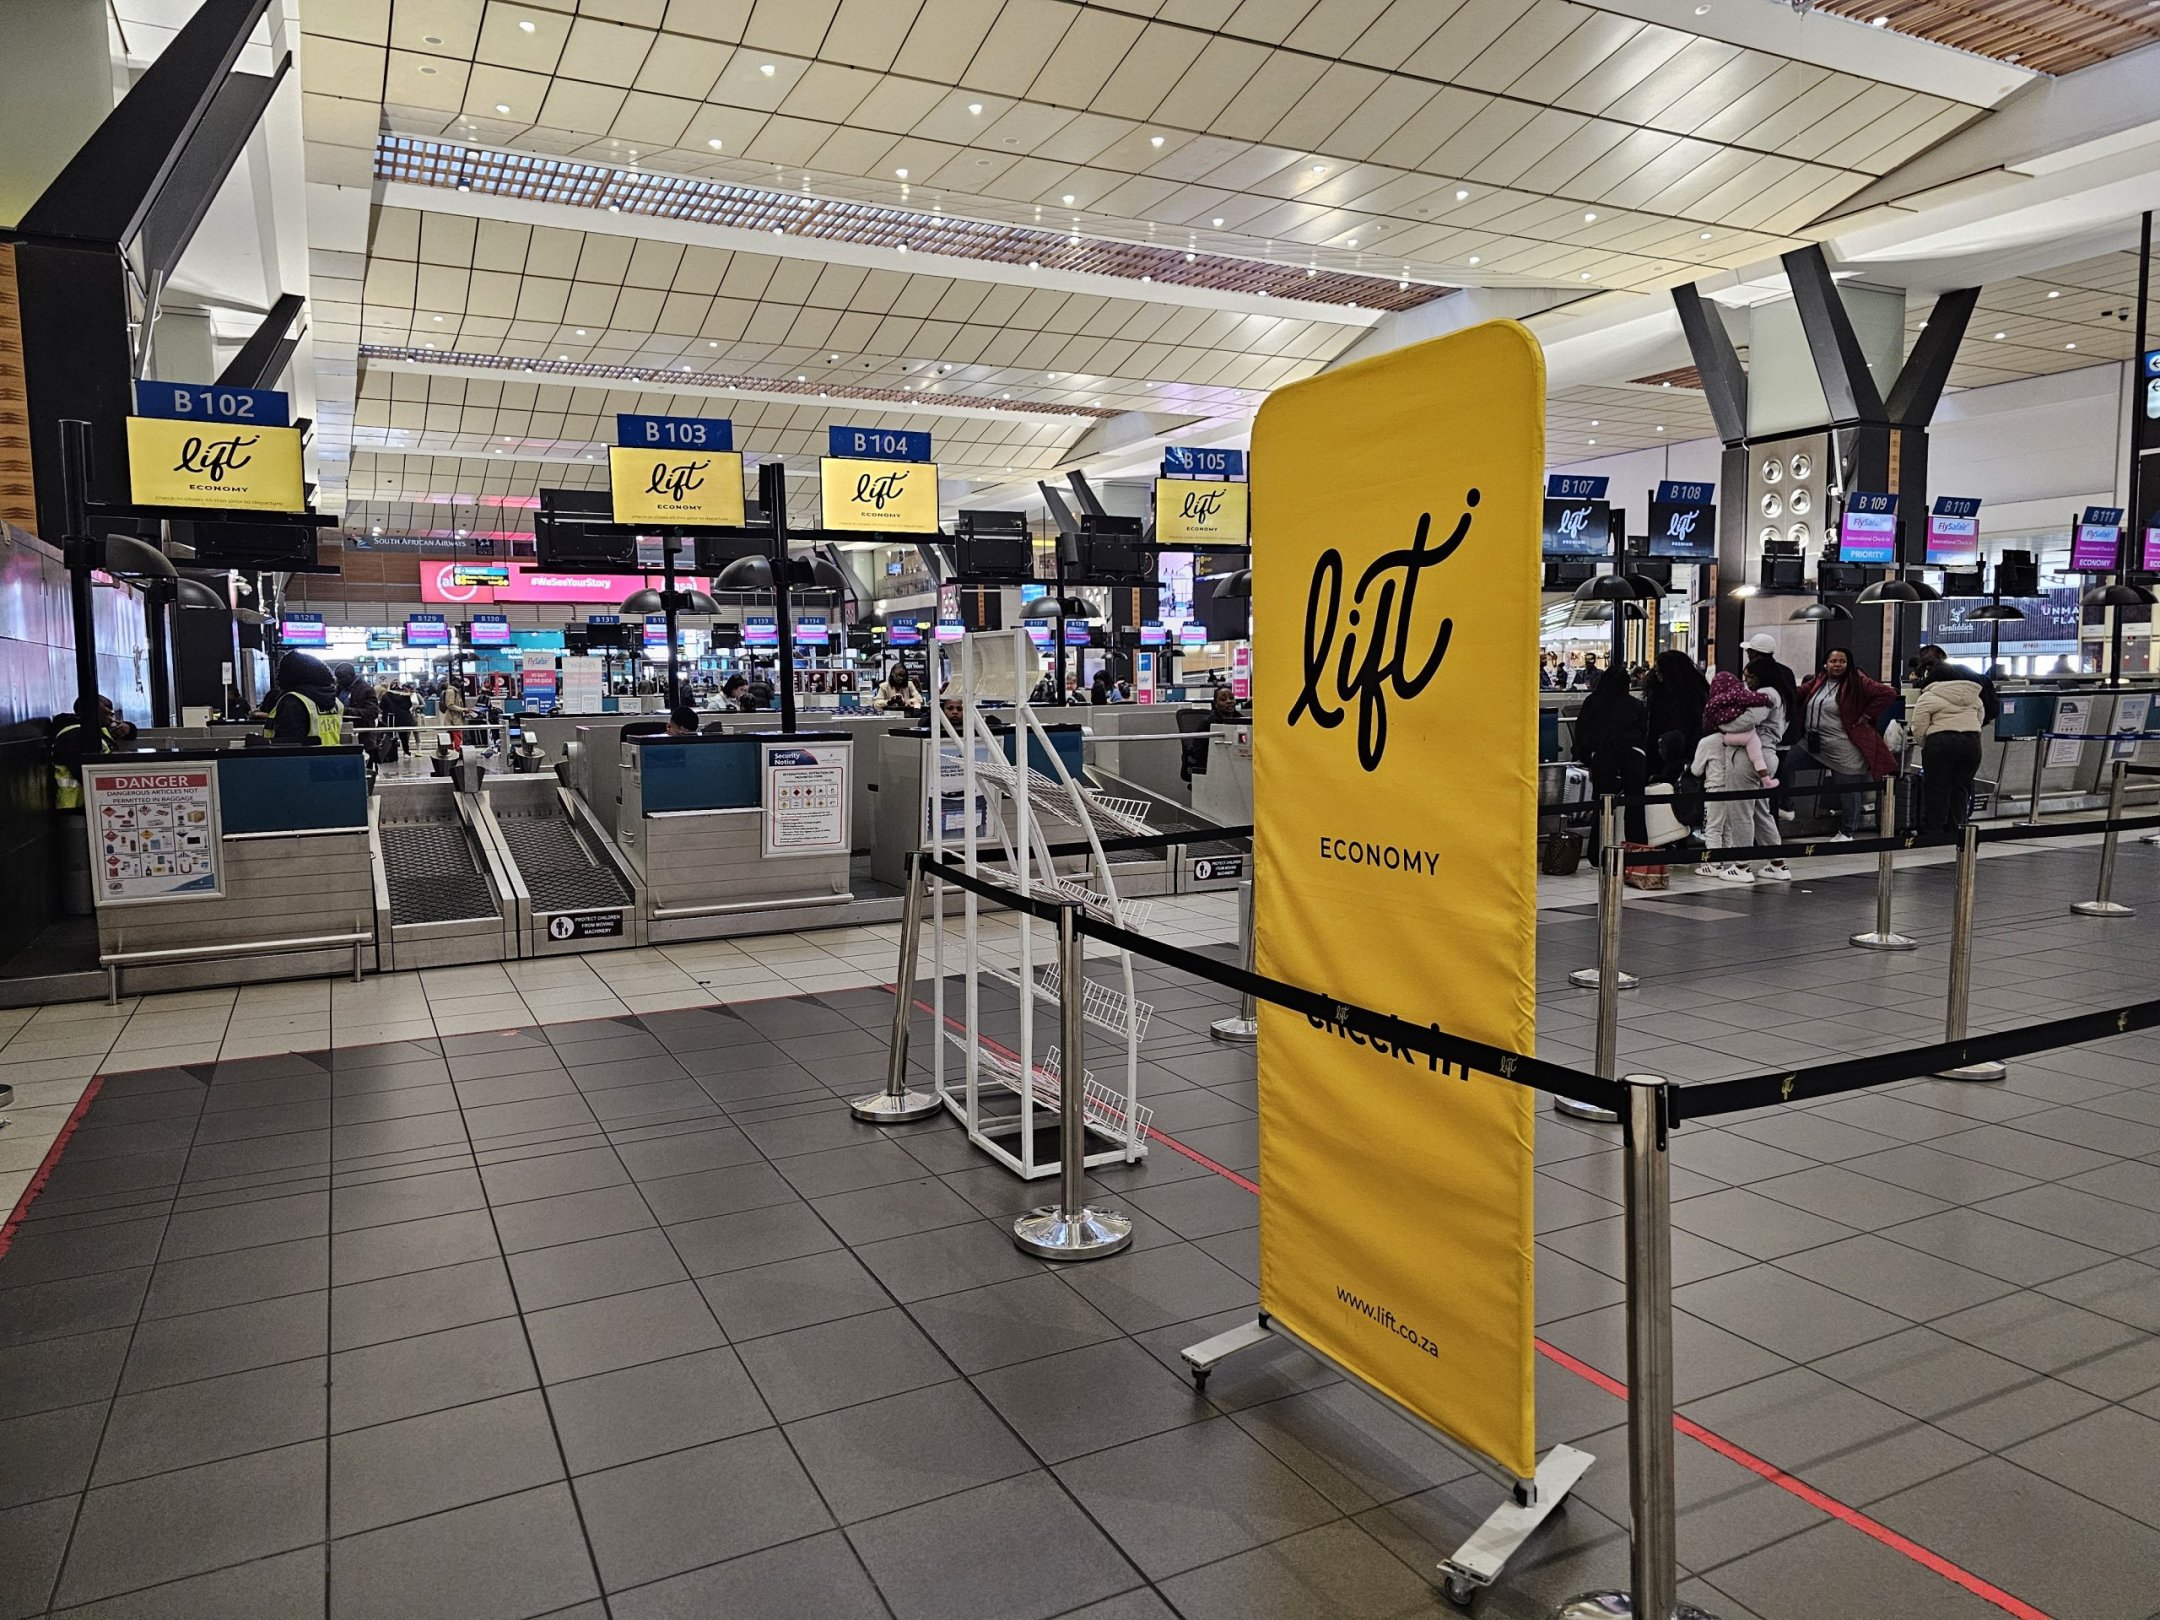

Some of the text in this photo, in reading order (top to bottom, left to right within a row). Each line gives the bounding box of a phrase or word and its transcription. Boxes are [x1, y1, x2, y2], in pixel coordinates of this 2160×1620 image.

[174, 389, 255, 418] B 102
[645, 421, 707, 444] B 103
[854, 432, 908, 455] B 104
[173, 434, 261, 482] lift
[1183, 452, 1226, 470] B 105
[189, 484, 249, 493] ECONOMY
[644, 459, 711, 502] lift
[1561, 479, 1595, 494] B 107
[851, 470, 910, 510] lift
[1670, 485, 1702, 500] B 108
[1178, 488, 1227, 524] lift
[1858, 496, 1888, 510] B 109
[1944, 500, 1971, 514] B 110
[1557, 506, 1593, 539] lift
[1666, 510, 1700, 541] lift
[2092, 510, 2116, 523] B 111
[1938, 523, 1968, 533] FlySafair
[373, 537, 467, 547] SOUTH AFRICAN AIRWAYS
[1850, 550, 1884, 558] PRIORITY
[2079, 559, 2111, 567] ECONOMY
[1287, 487, 1481, 773] lift
[1938, 622, 1974, 632] Glenfiddich
[527, 657, 549, 666] FlySafair
[774, 752, 801, 760] Security
[115, 775, 189, 789] DANGER
[1320, 836, 1441, 876] ECONOMY
[1335, 1004, 1350, 1025] lift
[1499, 1054, 1519, 1079] lift
[1335, 1284, 1439, 1358] www.lift.co.za
